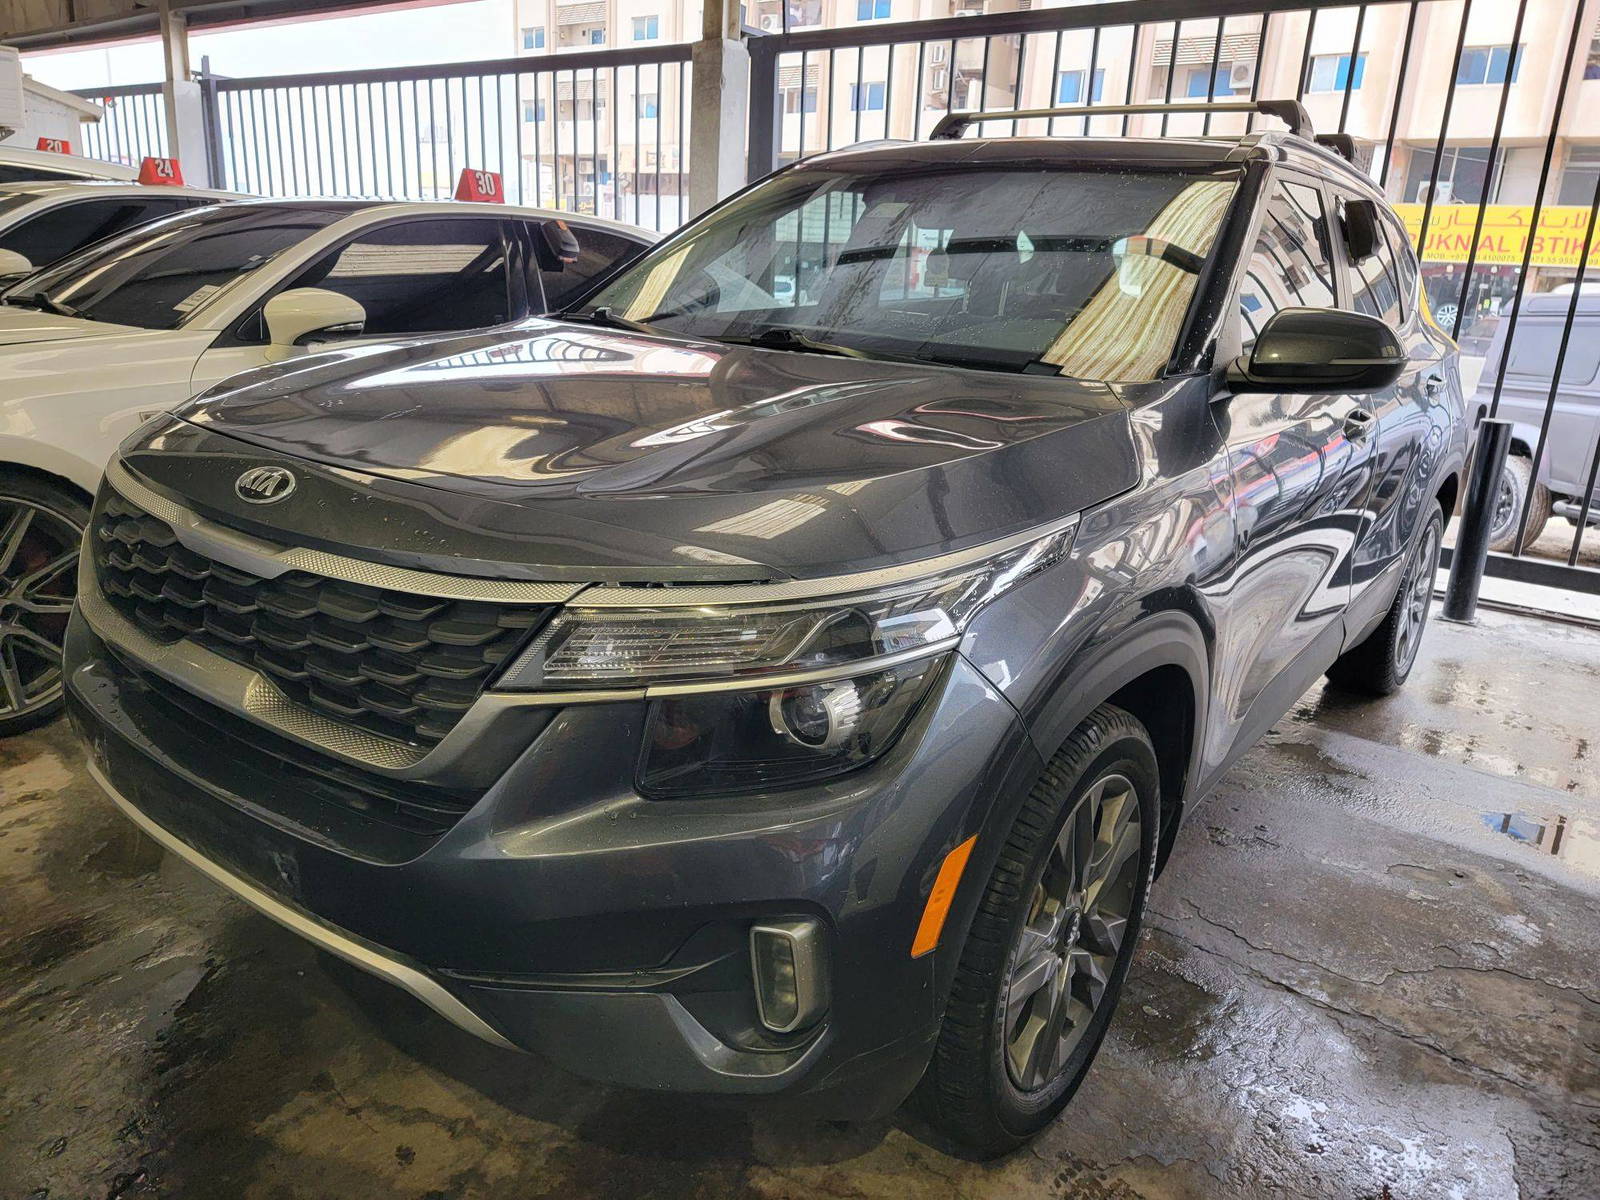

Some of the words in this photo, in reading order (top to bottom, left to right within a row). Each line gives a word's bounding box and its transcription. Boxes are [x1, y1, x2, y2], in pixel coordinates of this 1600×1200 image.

[46, 140, 62, 153] 20
[155, 160, 173, 177] 24
[475, 171, 496, 196] 30
[1477, 234, 1511, 253] AL
